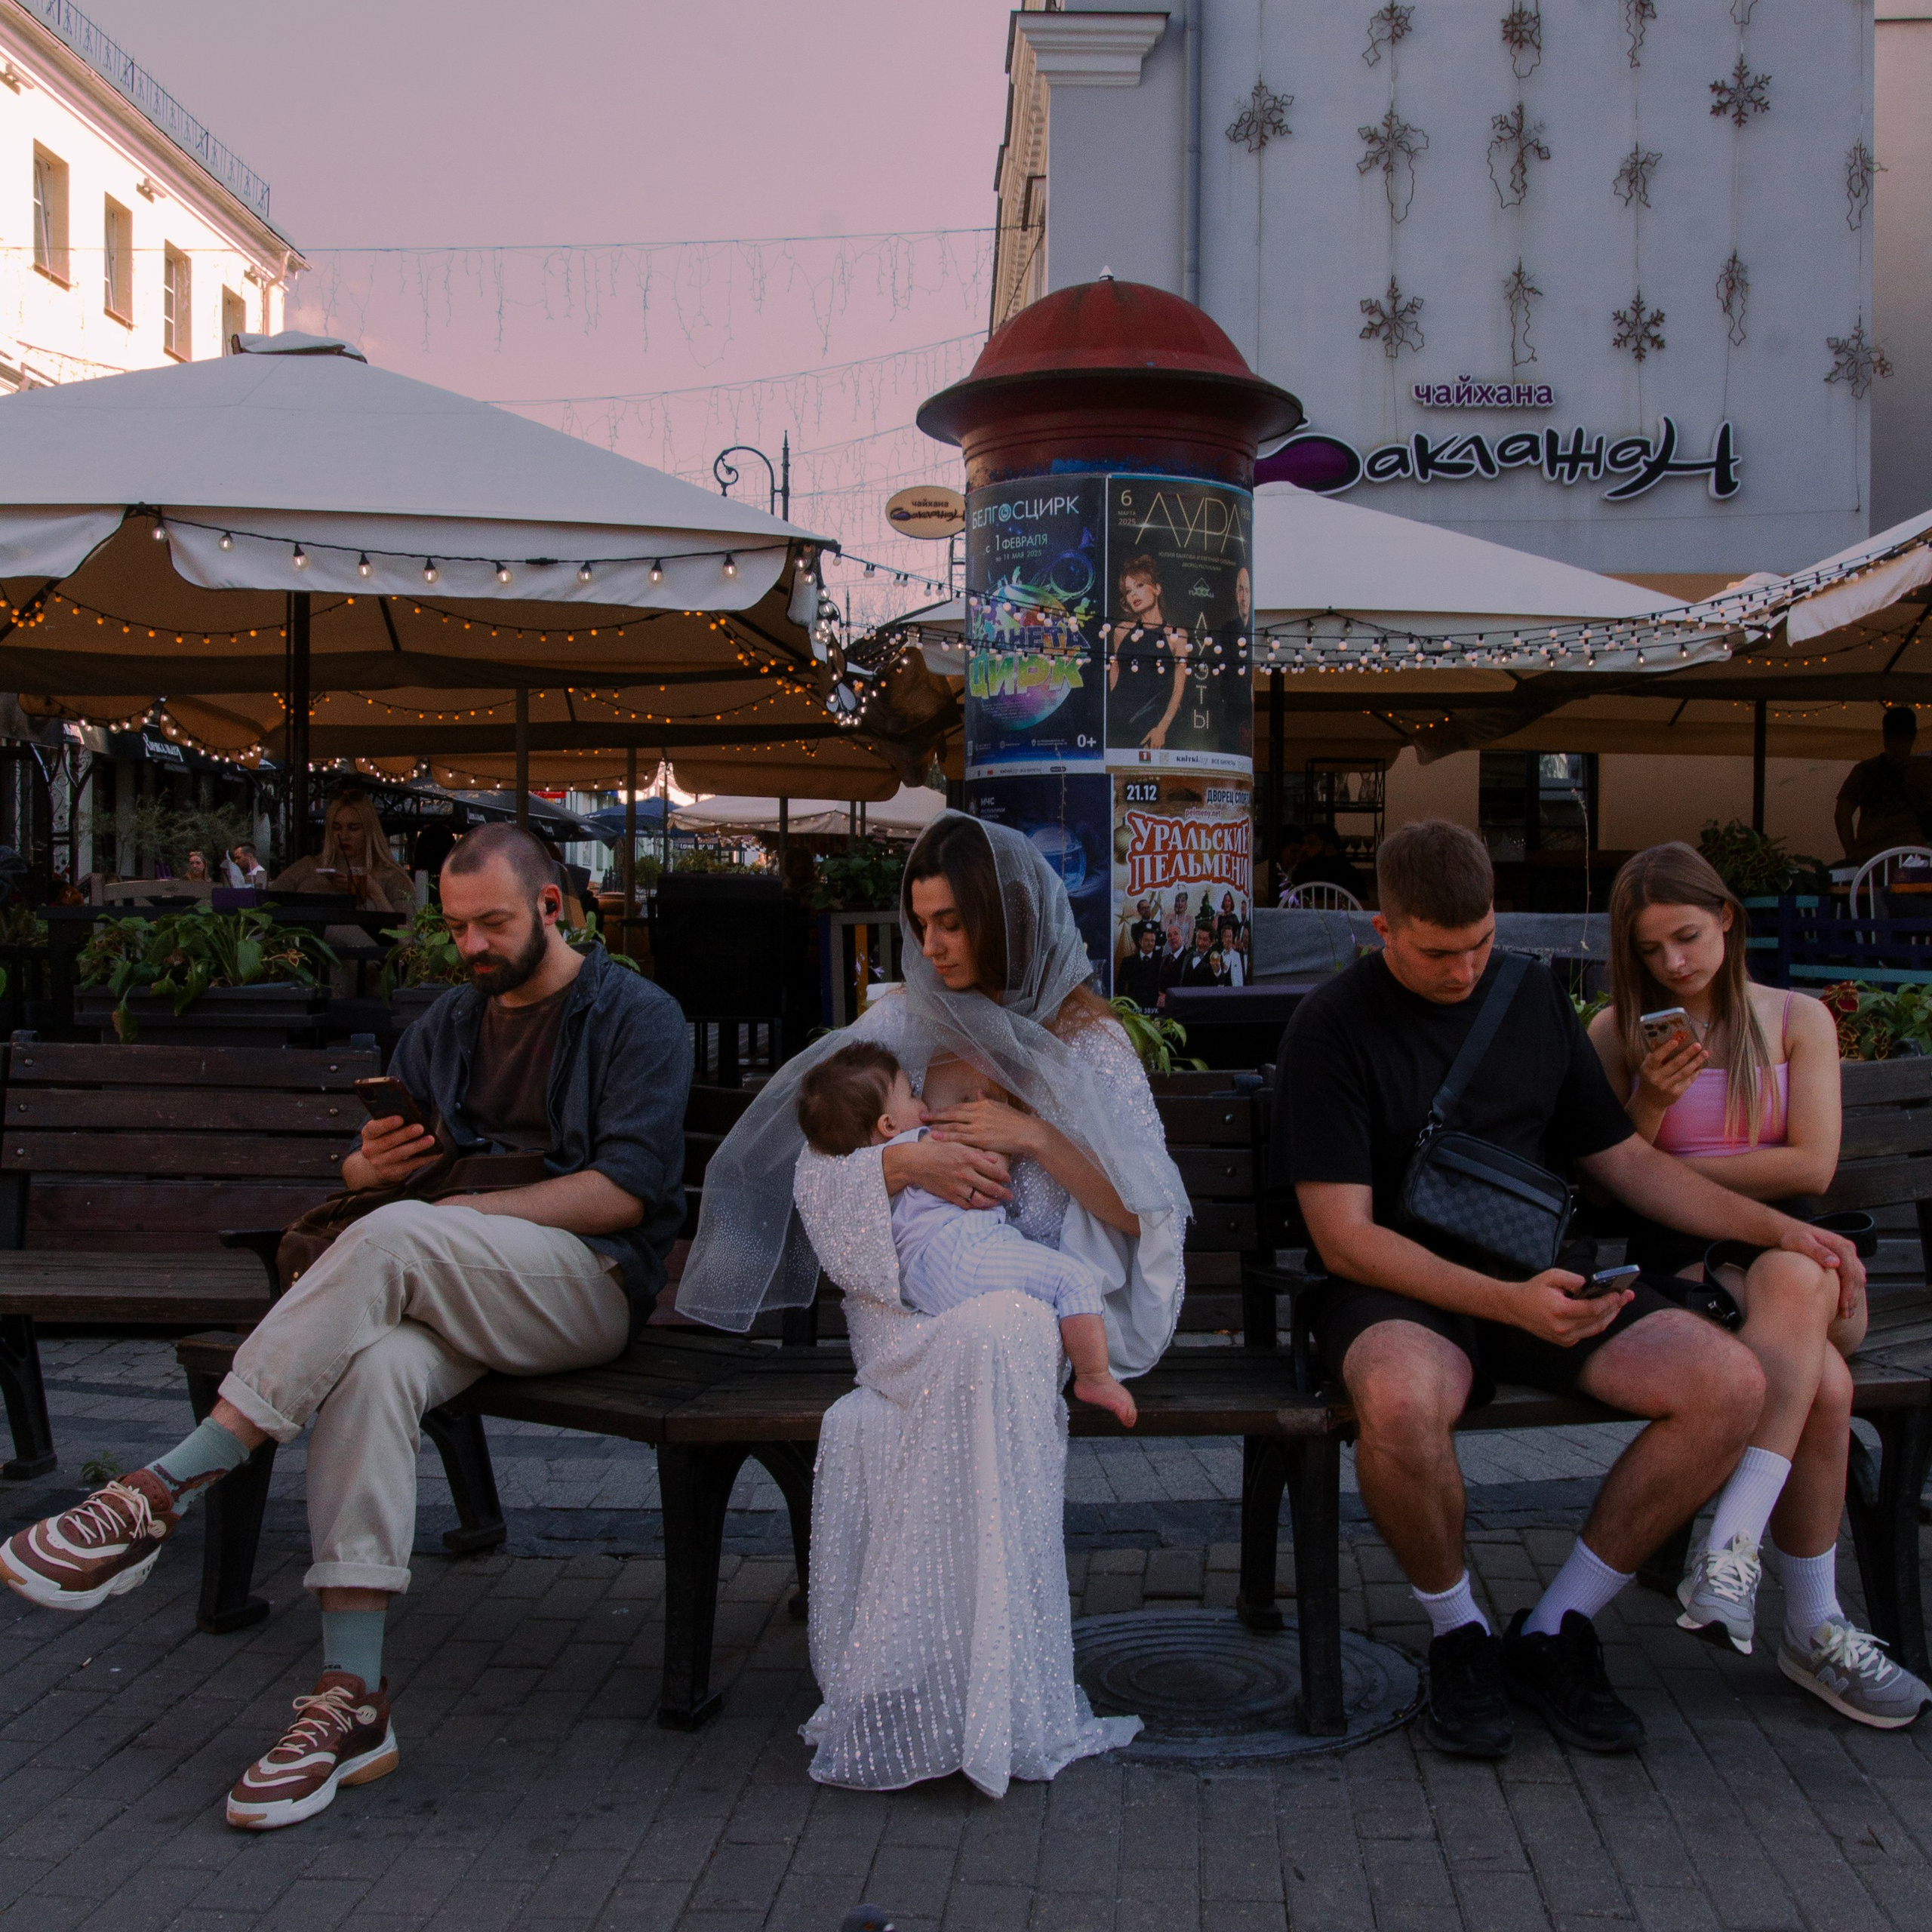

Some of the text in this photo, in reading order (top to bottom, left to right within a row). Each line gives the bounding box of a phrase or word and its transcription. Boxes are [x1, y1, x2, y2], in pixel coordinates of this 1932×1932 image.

[1413, 373, 1555, 408] чайхана
[912, 499, 949, 508] чайхана
[1121, 489, 1132, 506] 6
[972, 495, 1080, 530] БЕЛГОСЦИРК
[1118, 518, 1136, 526] 2025
[995, 534, 999, 551] 1
[1001, 533, 1048, 549] ФЕВРАЛЯ
[1027, 549, 1042, 558] 2025
[969, 652, 1088, 699] ЦИРК
[1077, 734, 1097, 748] 0+
[980, 796, 995, 806] МЧС
[1126, 784, 1158, 801] 21.12
[1207, 789, 1233, 806] ДВОРЕЦ
[1185, 808, 1221, 819] pelmeny.net
[1131, 817, 1248, 854] УРАЛЬСКИЕ
[1131, 852, 1248, 893] ПЕЛЬМЕНИ
